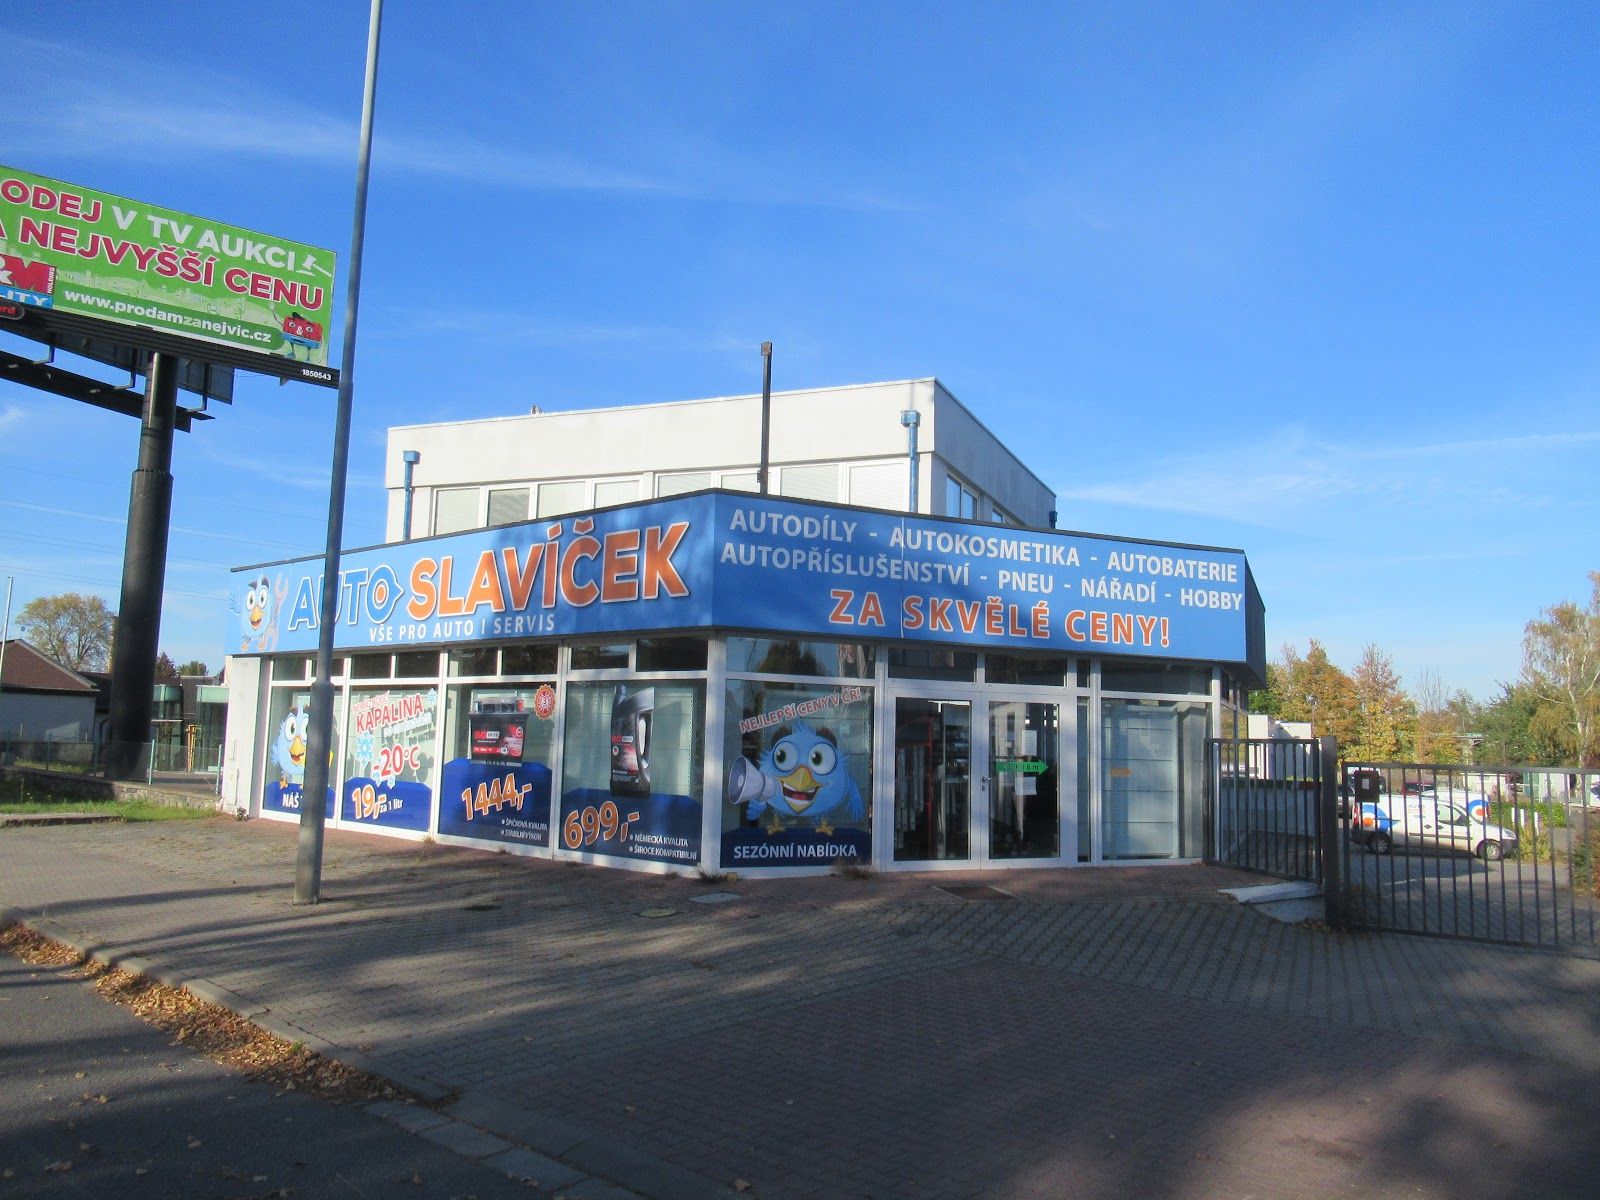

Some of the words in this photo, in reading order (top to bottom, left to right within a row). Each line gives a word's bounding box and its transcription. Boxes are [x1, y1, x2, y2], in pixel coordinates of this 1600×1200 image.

[112, 205, 137, 230] V
[147, 215, 194, 244] TV
[196, 229, 296, 272] AUKCI
[18, 215, 220, 287] NEJVYŠŠÍ
[223, 267, 324, 311] CENU
[64, 289, 272, 343] www.prodamzanejvic.cz
[302, 369, 332, 381] 1850543
[407, 516, 690, 621] SLAVÍČEK
[730, 509, 857, 543] AUTODÍLY
[889, 527, 1080, 567] AUTOKOSMETIKA
[1107, 552, 1238, 583] AUTOBATERIE
[720, 542, 969, 586] AUTOPŘÍSLUŠENSTVÍ
[998, 570, 1054, 594] PNEU
[1081, 576, 1156, 603] NÁŘADÍ
[1180, 588, 1243, 611] HOBBY
[369, 624, 393, 642] VŠE
[400, 622, 426, 640] PRO
[433, 619, 474, 638] AUTO
[494, 613, 555, 635] SERVIS
[829, 588, 886, 627] ZA
[903, 595, 1051, 640] SKVĚLÉ
[1064, 609, 1170, 648] CENY!
[355, 693, 424, 734] KAPALINA
[738, 702, 797, 734] NEJLEPŠÍ
[798, 698, 830, 717] CENY
[841, 686, 863, 704] ČR!
[282, 792, 299, 809] NÁŠ
[393, 799, 404, 810] litr
[461, 772, 533, 821] 1444,-
[563, 800, 640, 849] 699,-
[634, 832, 663, 845] NĚMECKÁ
[663, 836, 688, 847] KVALITA
[634, 844, 655, 855] ŠIROCE
[655, 847, 697, 860] KOMPATIBILNÍ
[733, 842, 795, 859] SEZÓNNÍ
[797, 841, 857, 858] NABÍDKA
